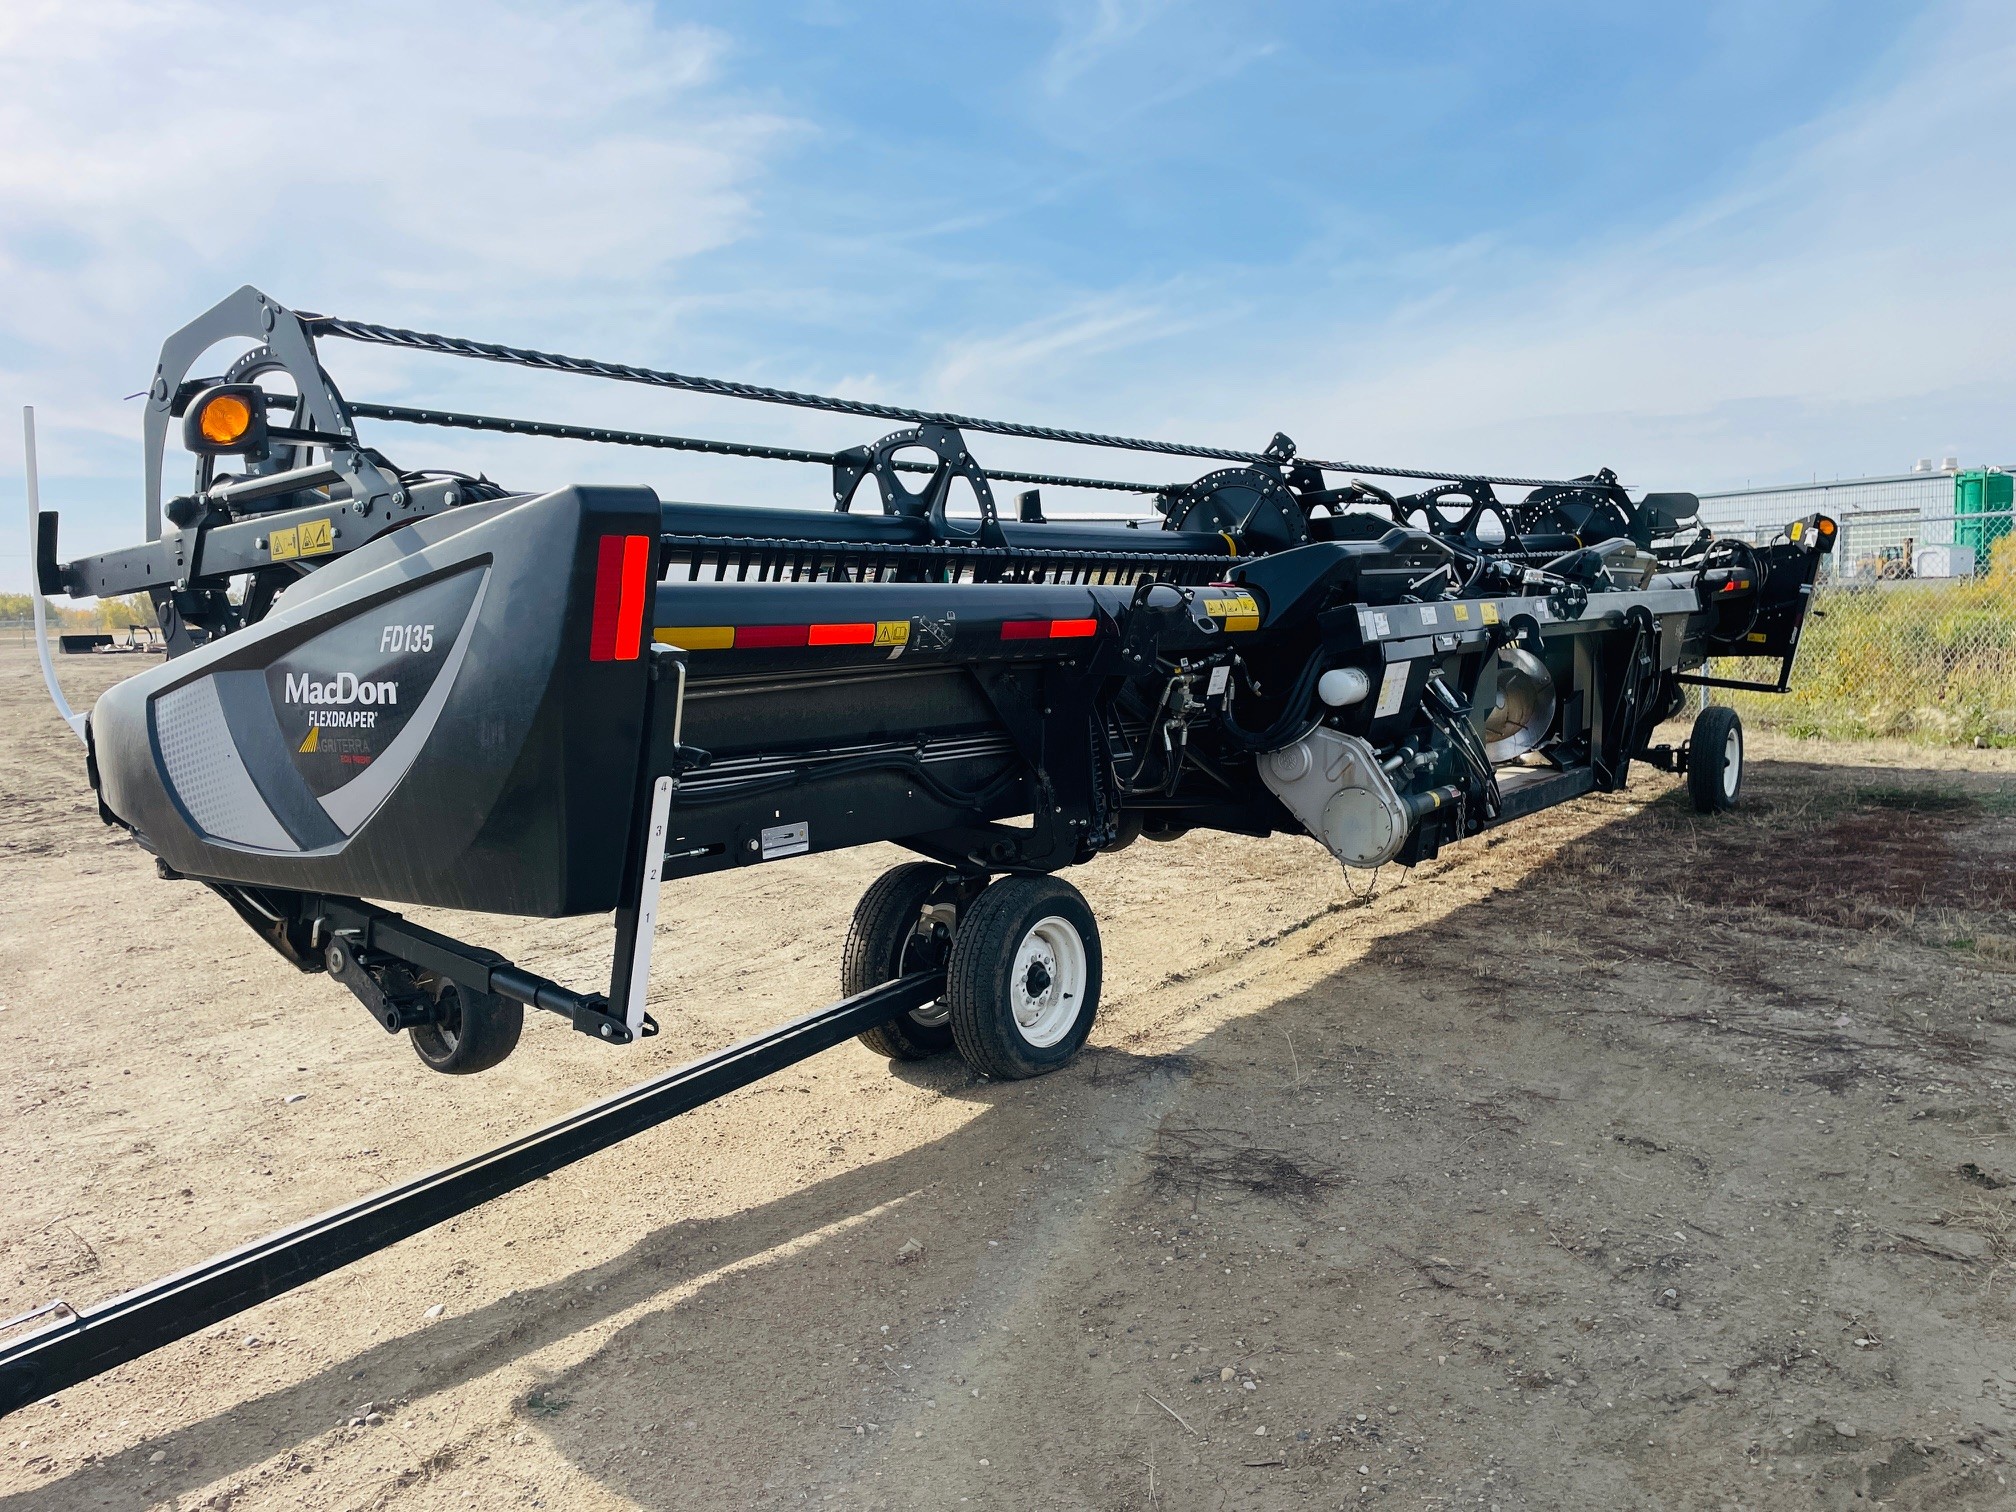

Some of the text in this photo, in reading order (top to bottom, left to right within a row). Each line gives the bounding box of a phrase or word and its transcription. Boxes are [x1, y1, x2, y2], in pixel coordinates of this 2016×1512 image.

[379, 624, 435, 653] FD135
[284, 672, 398, 705] MacDon
[308, 710, 375, 728] FLEXDRAPER
[316, 738, 370, 753] AGRITERRA
[661, 781, 667, 792] 4
[655, 825, 662, 836] 3
[650, 869, 657, 880] 2
